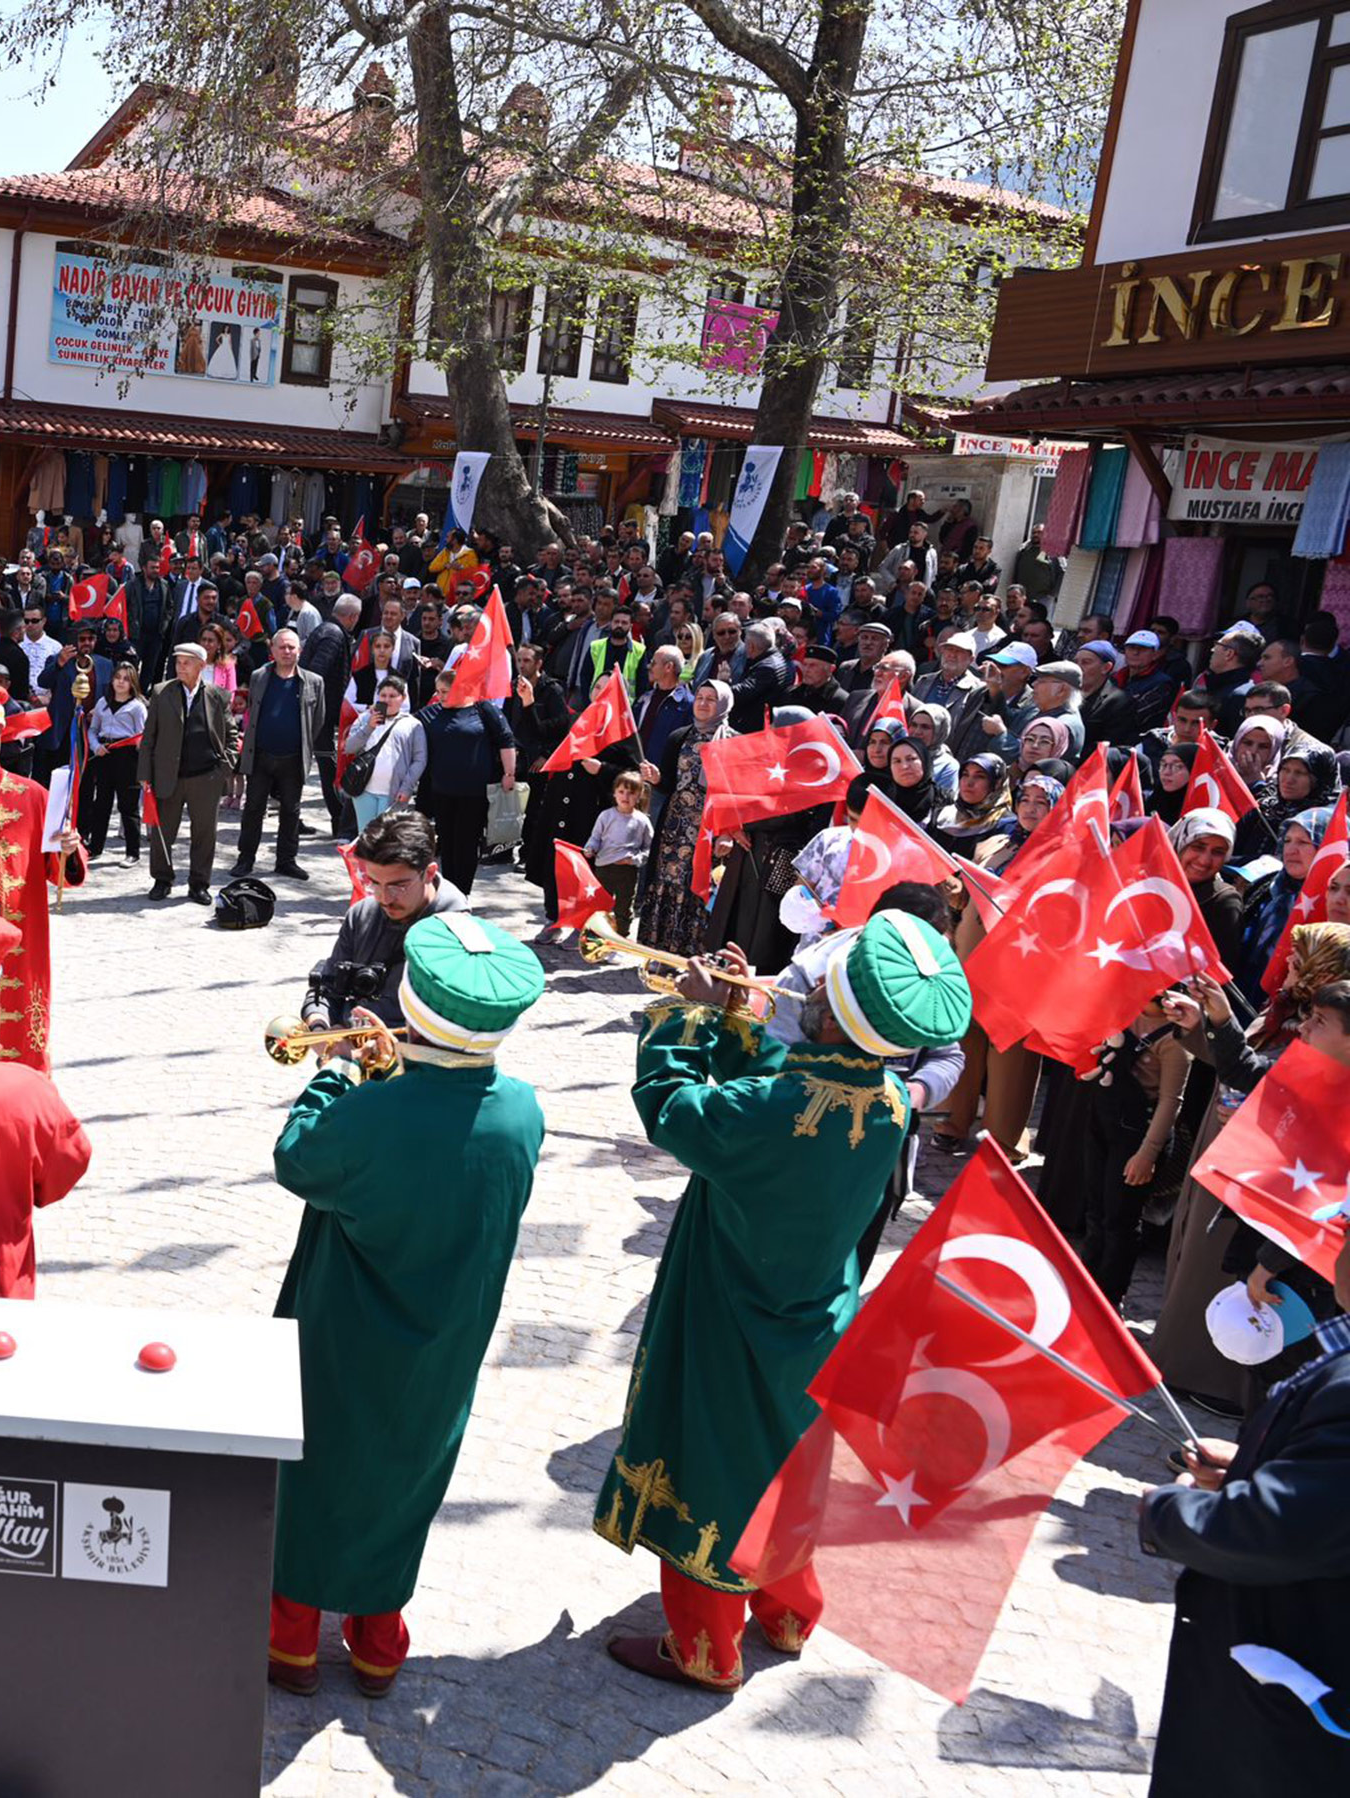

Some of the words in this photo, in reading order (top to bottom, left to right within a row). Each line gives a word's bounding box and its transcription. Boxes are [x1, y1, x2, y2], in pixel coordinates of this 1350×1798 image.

[1101, 253, 1341, 348] İNCE
[960, 434, 1003, 451] İNCE
[1183, 438, 1262, 490] İNCE
[1187, 500, 1262, 520] MUSTAFA
